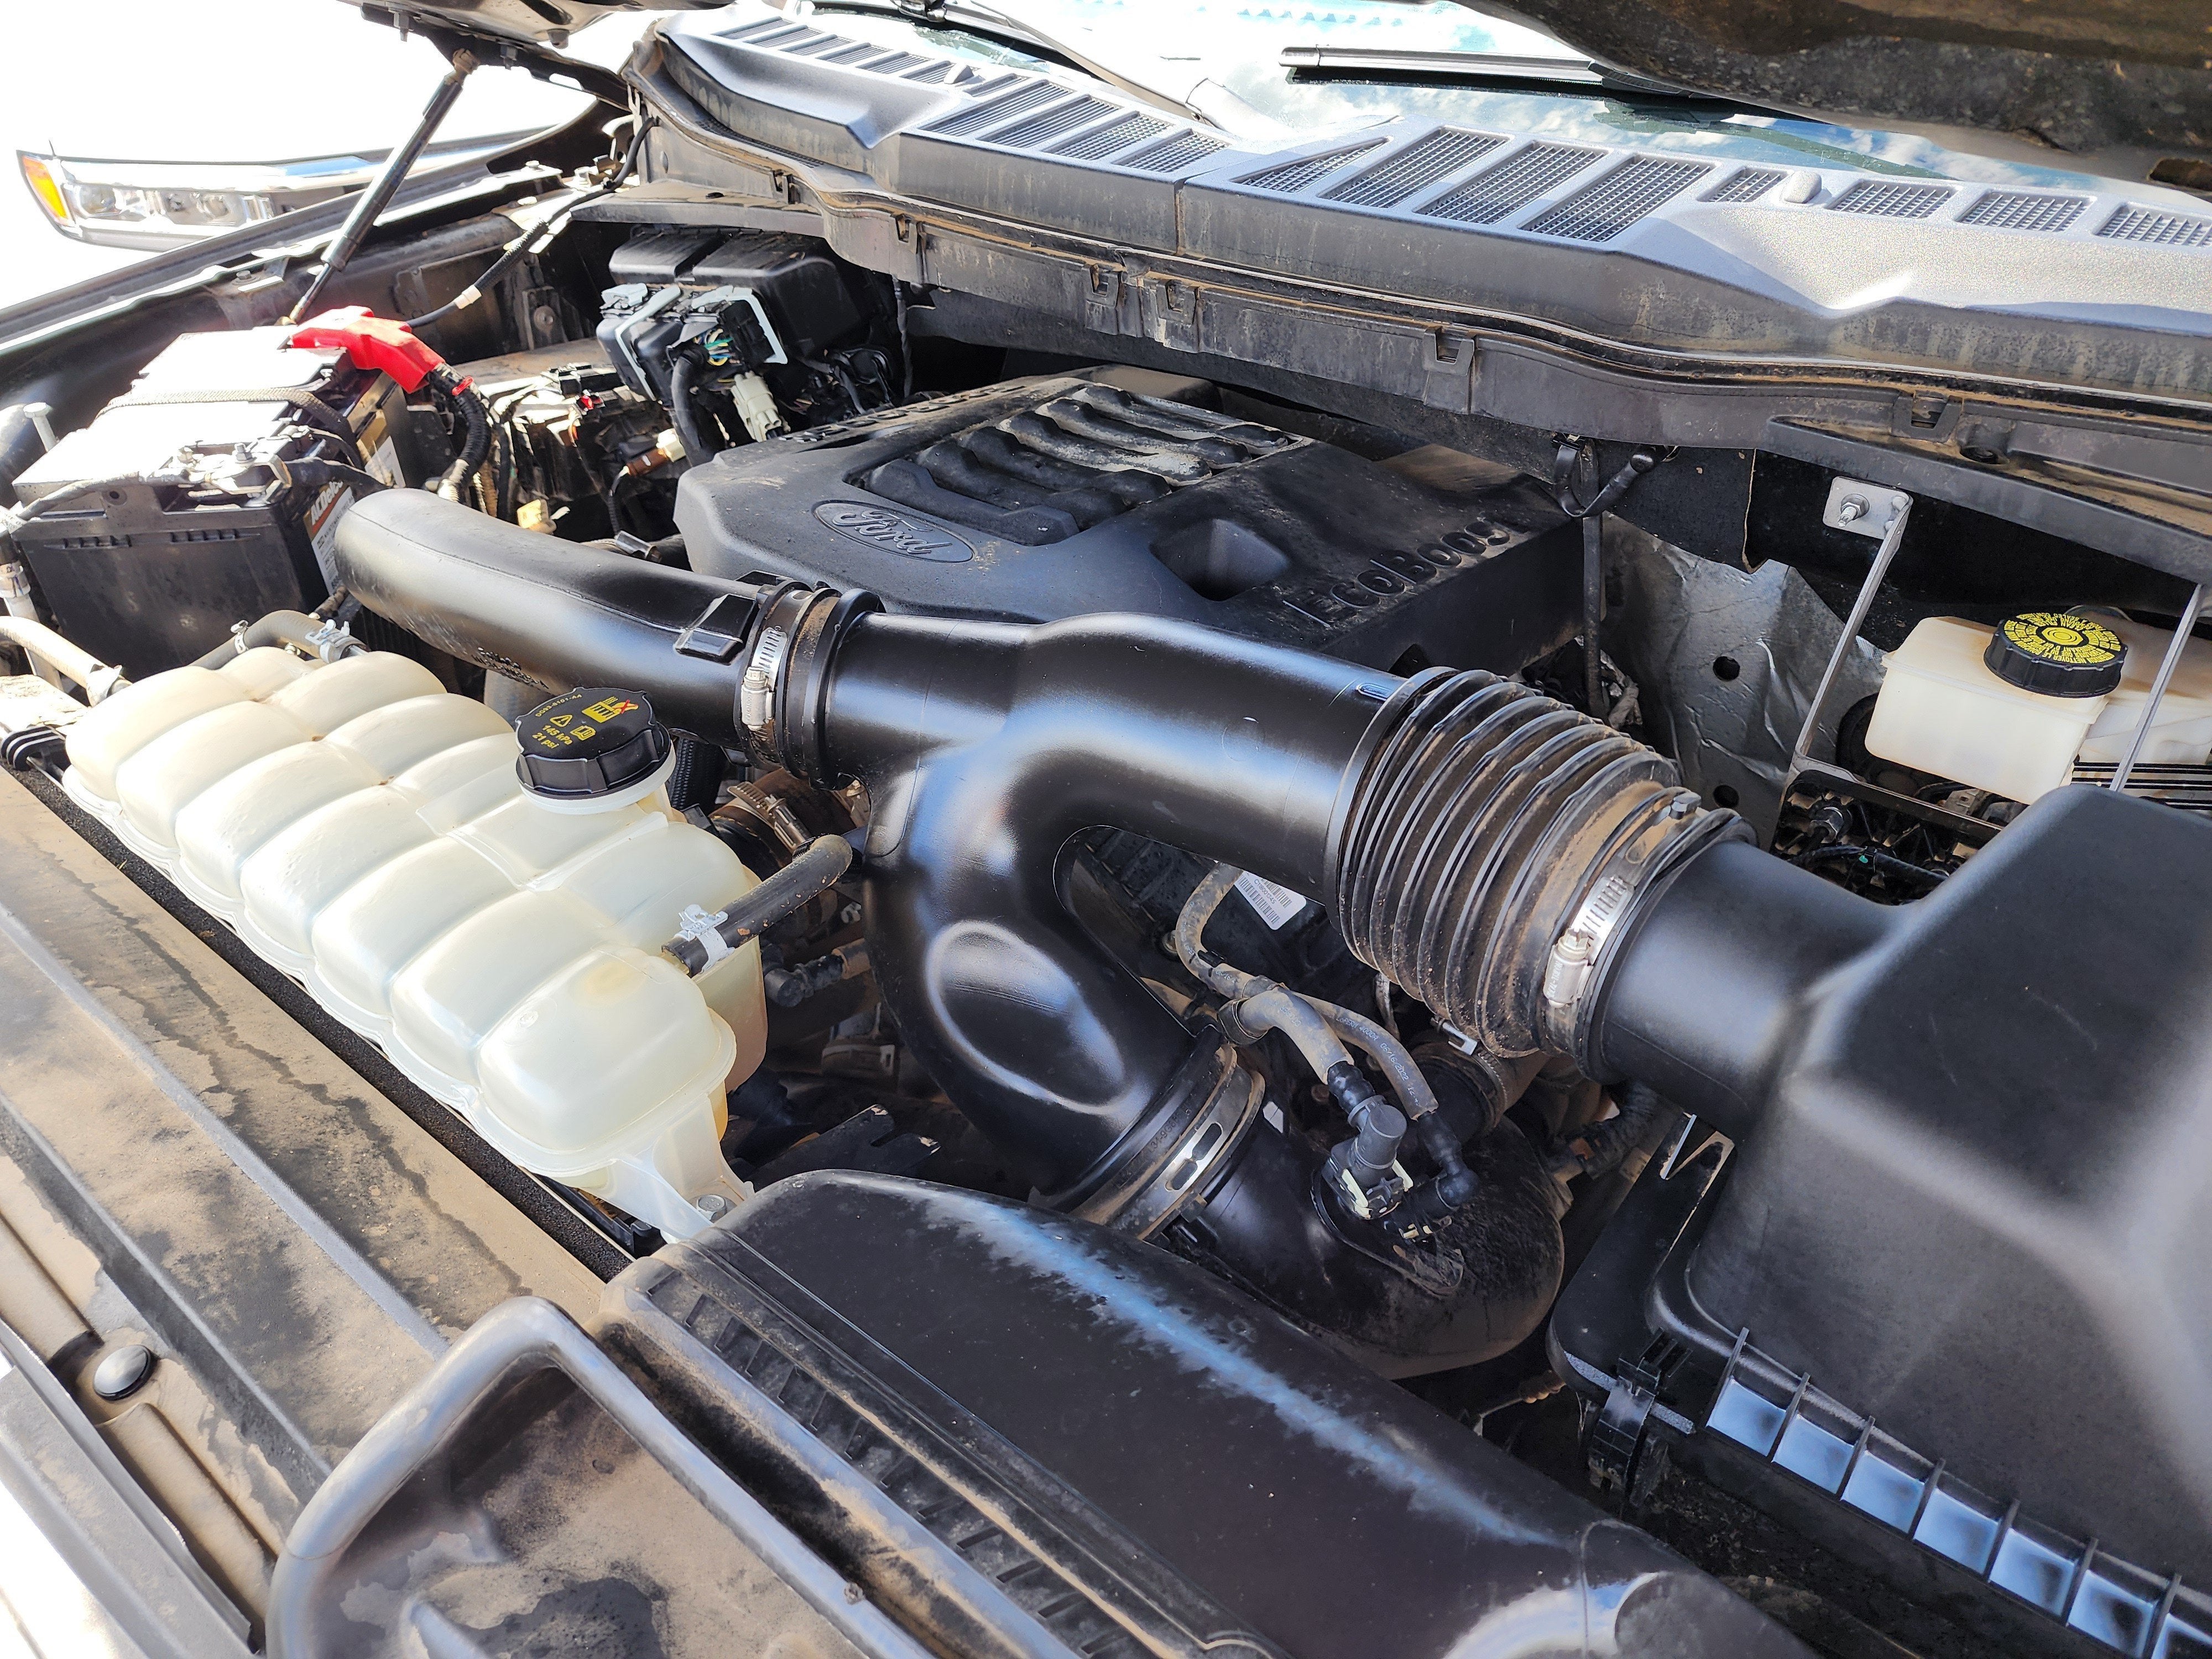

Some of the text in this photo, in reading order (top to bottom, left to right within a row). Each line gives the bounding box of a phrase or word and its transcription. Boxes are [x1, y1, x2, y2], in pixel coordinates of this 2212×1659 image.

[832, 509, 952, 554] Ford
[532, 732, 560, 749] 21 psi
[542, 725, 573, 745] 145 kPa
